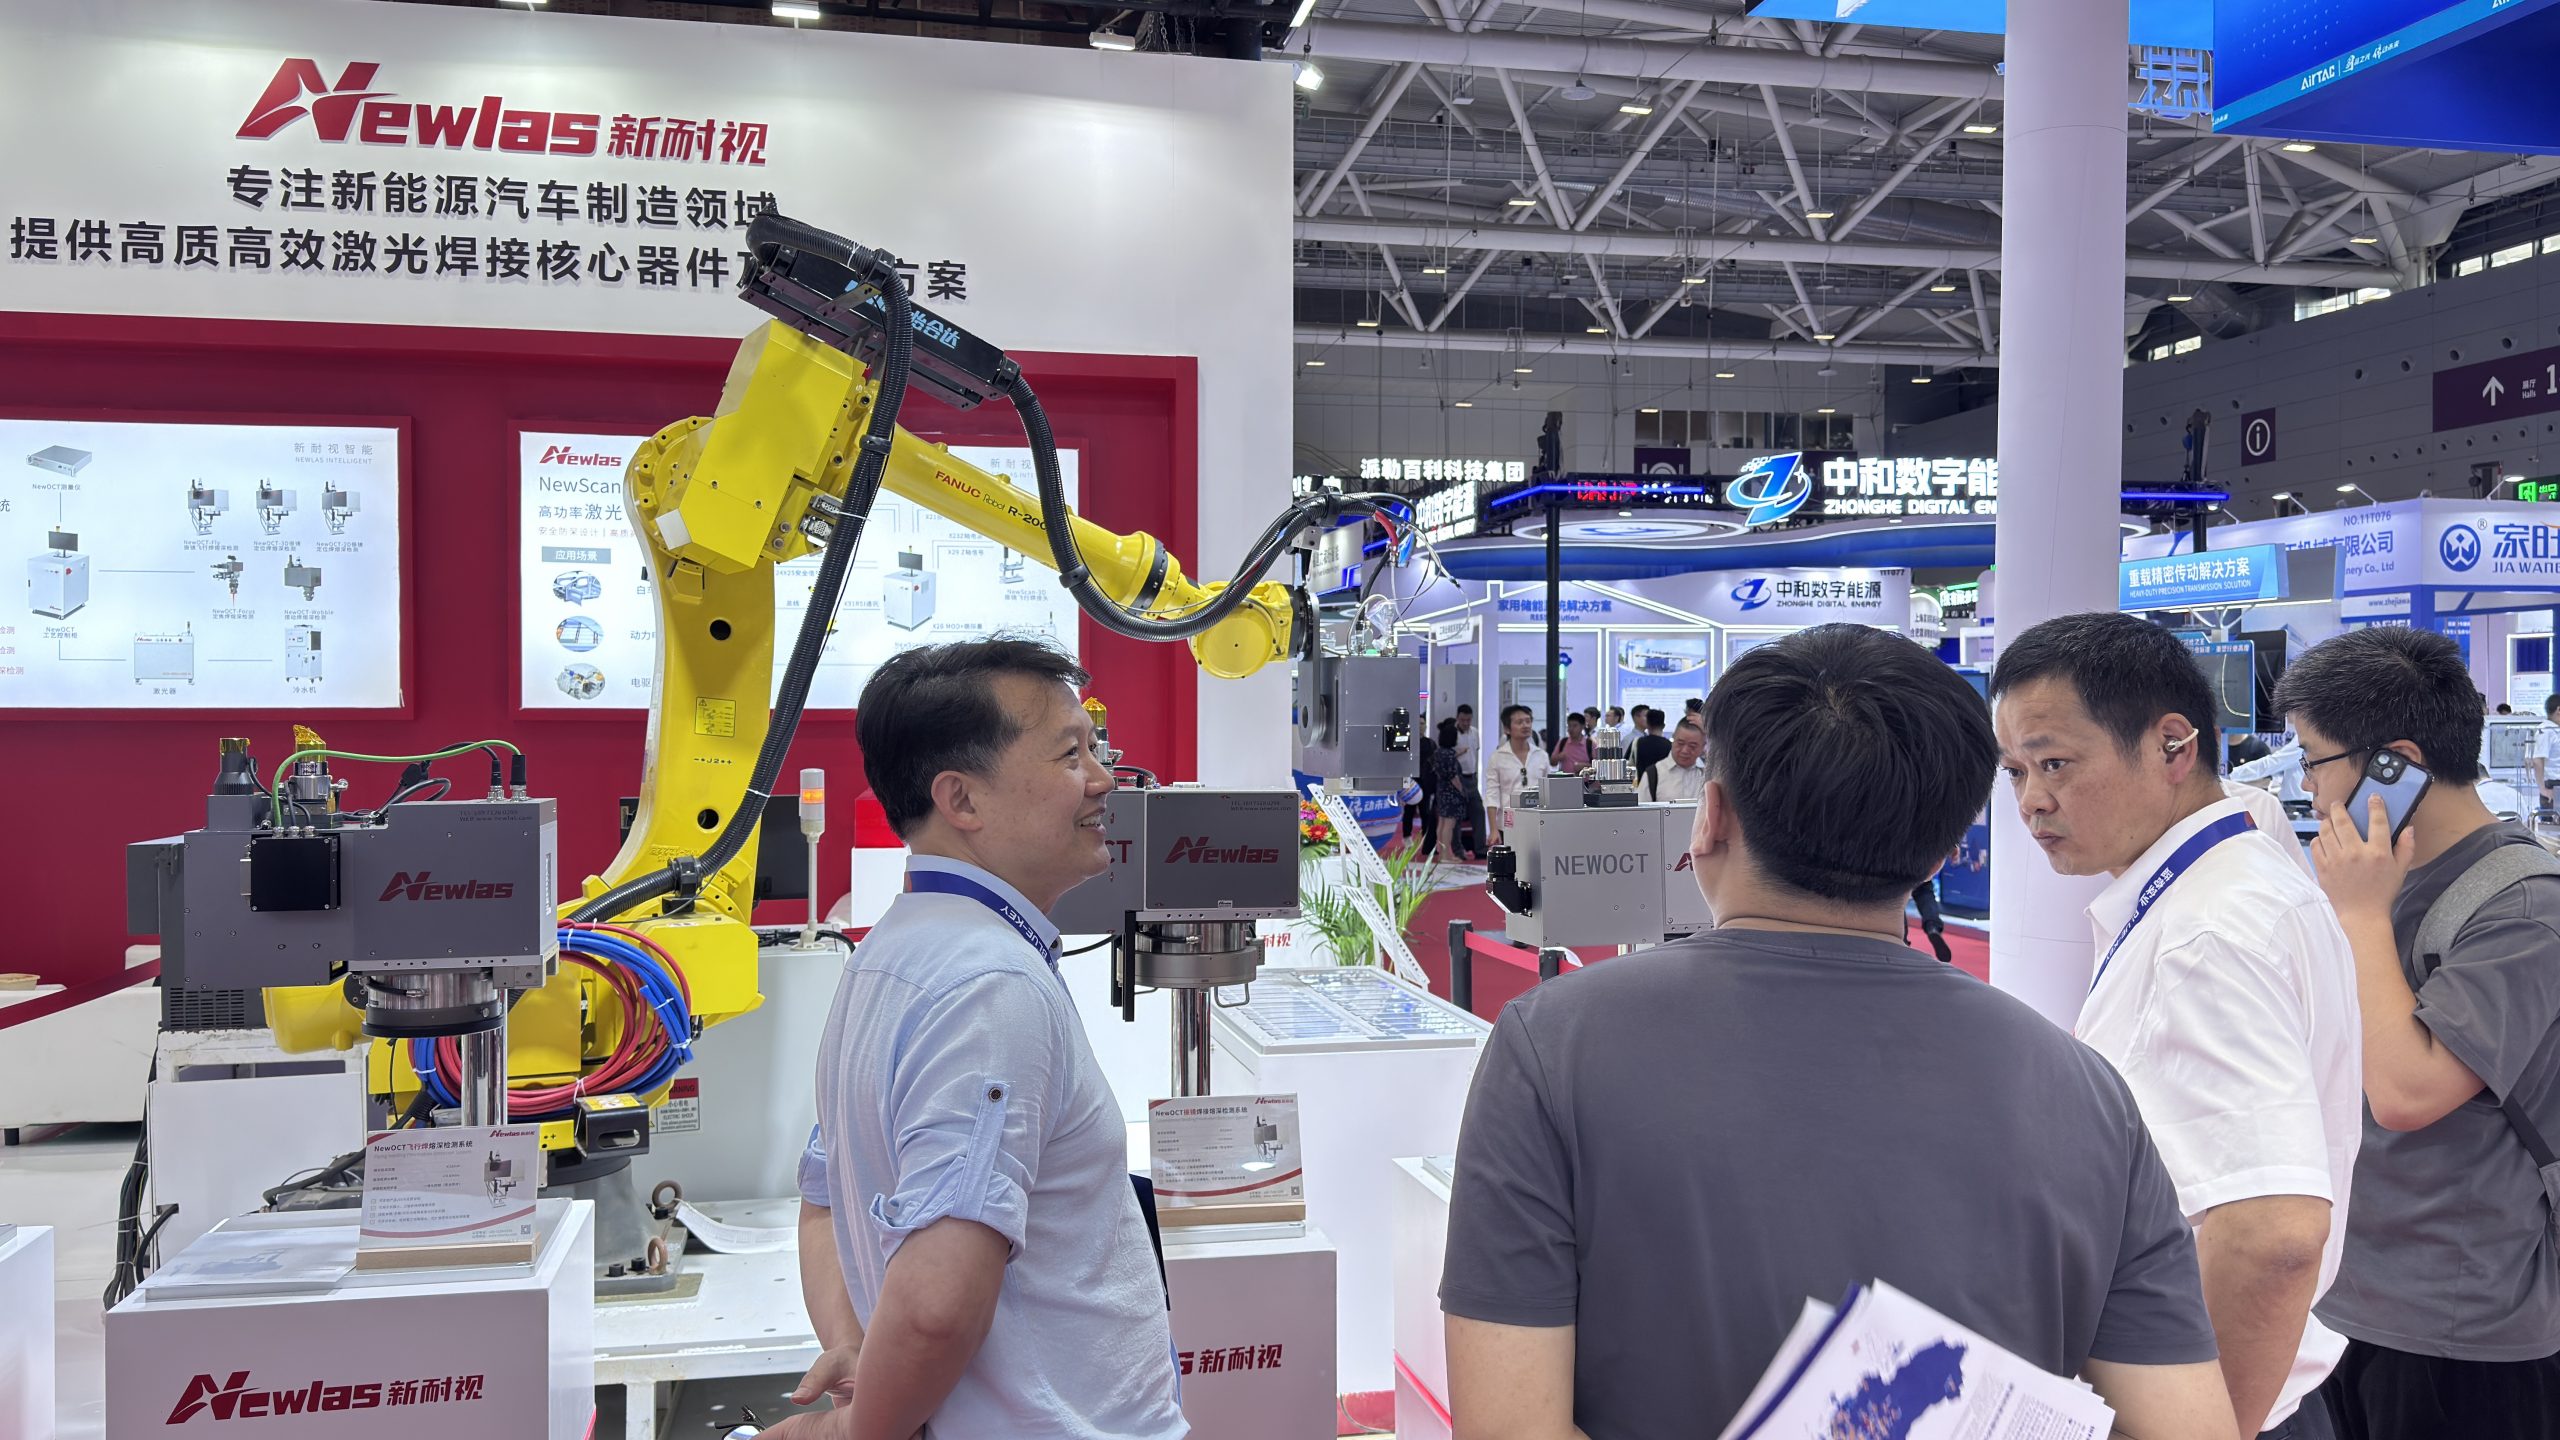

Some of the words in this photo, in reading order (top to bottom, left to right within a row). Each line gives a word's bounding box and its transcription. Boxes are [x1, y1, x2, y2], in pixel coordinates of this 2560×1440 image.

[236, 57, 602, 157] Newlas
[606, 113, 770, 167] 新耐视
[227, 164, 776, 230] 专注新能源汽车制造领域
[2522, 389, 2537, 400] Halls
[293, 442, 374, 456] 新耐视智能
[540, 445, 622, 467] Newlas
[325, 457, 373, 465] INTELLIGENT
[1360, 458, 1526, 483] 派勒百利科技集团
[539, 476, 621, 494] NewScan
[1823, 456, 1998, 497] 中和数字能
[935, 470, 981, 498] FANUC
[982, 493, 1006, 511] Robot
[538, 503, 622, 521] 高功率激光
[1823, 499, 1902, 516] ZHONGHE
[1907, 499, 1969, 516] DIGITAL
[2343, 510, 2392, 527] NO.11T076
[555, 550, 598, 561] 应用场景
[2128, 557, 2251, 588] 重载精密传动解决方案
[2381, 561, 2395, 572] Ltd
[2492, 562, 2515, 574] JIA
[1776, 579, 1882, 599] 中和数字能源
[2129, 588, 2159, 598] HEAVY-DUTY
[2159, 585, 2185, 596] PRECISION
[2184, 582, 2223, 593] TRANSMISSION
[2223, 579, 2252, 590] SOLUTION
[1497, 599, 1612, 612] 家用储能统解决方案
[1776, 600, 1815, 608] ZHONGHE
[1817, 600, 1849, 608] DIGITAL
[1850, 600, 1882, 609] ENERGY
[153, 687, 177, 695] 激光器
[1164, 836, 1280, 864] Newlas
[1554, 853, 1649, 876] NEWOCT
[378, 870, 515, 903] Newlas
[1000, 904, 1048, 961] BLUE-KEY
[1198, 1343, 1283, 1374] 新耐视
[165, 1370, 383, 1426] Newlas
[386, 1374, 485, 1407] 新耐视
